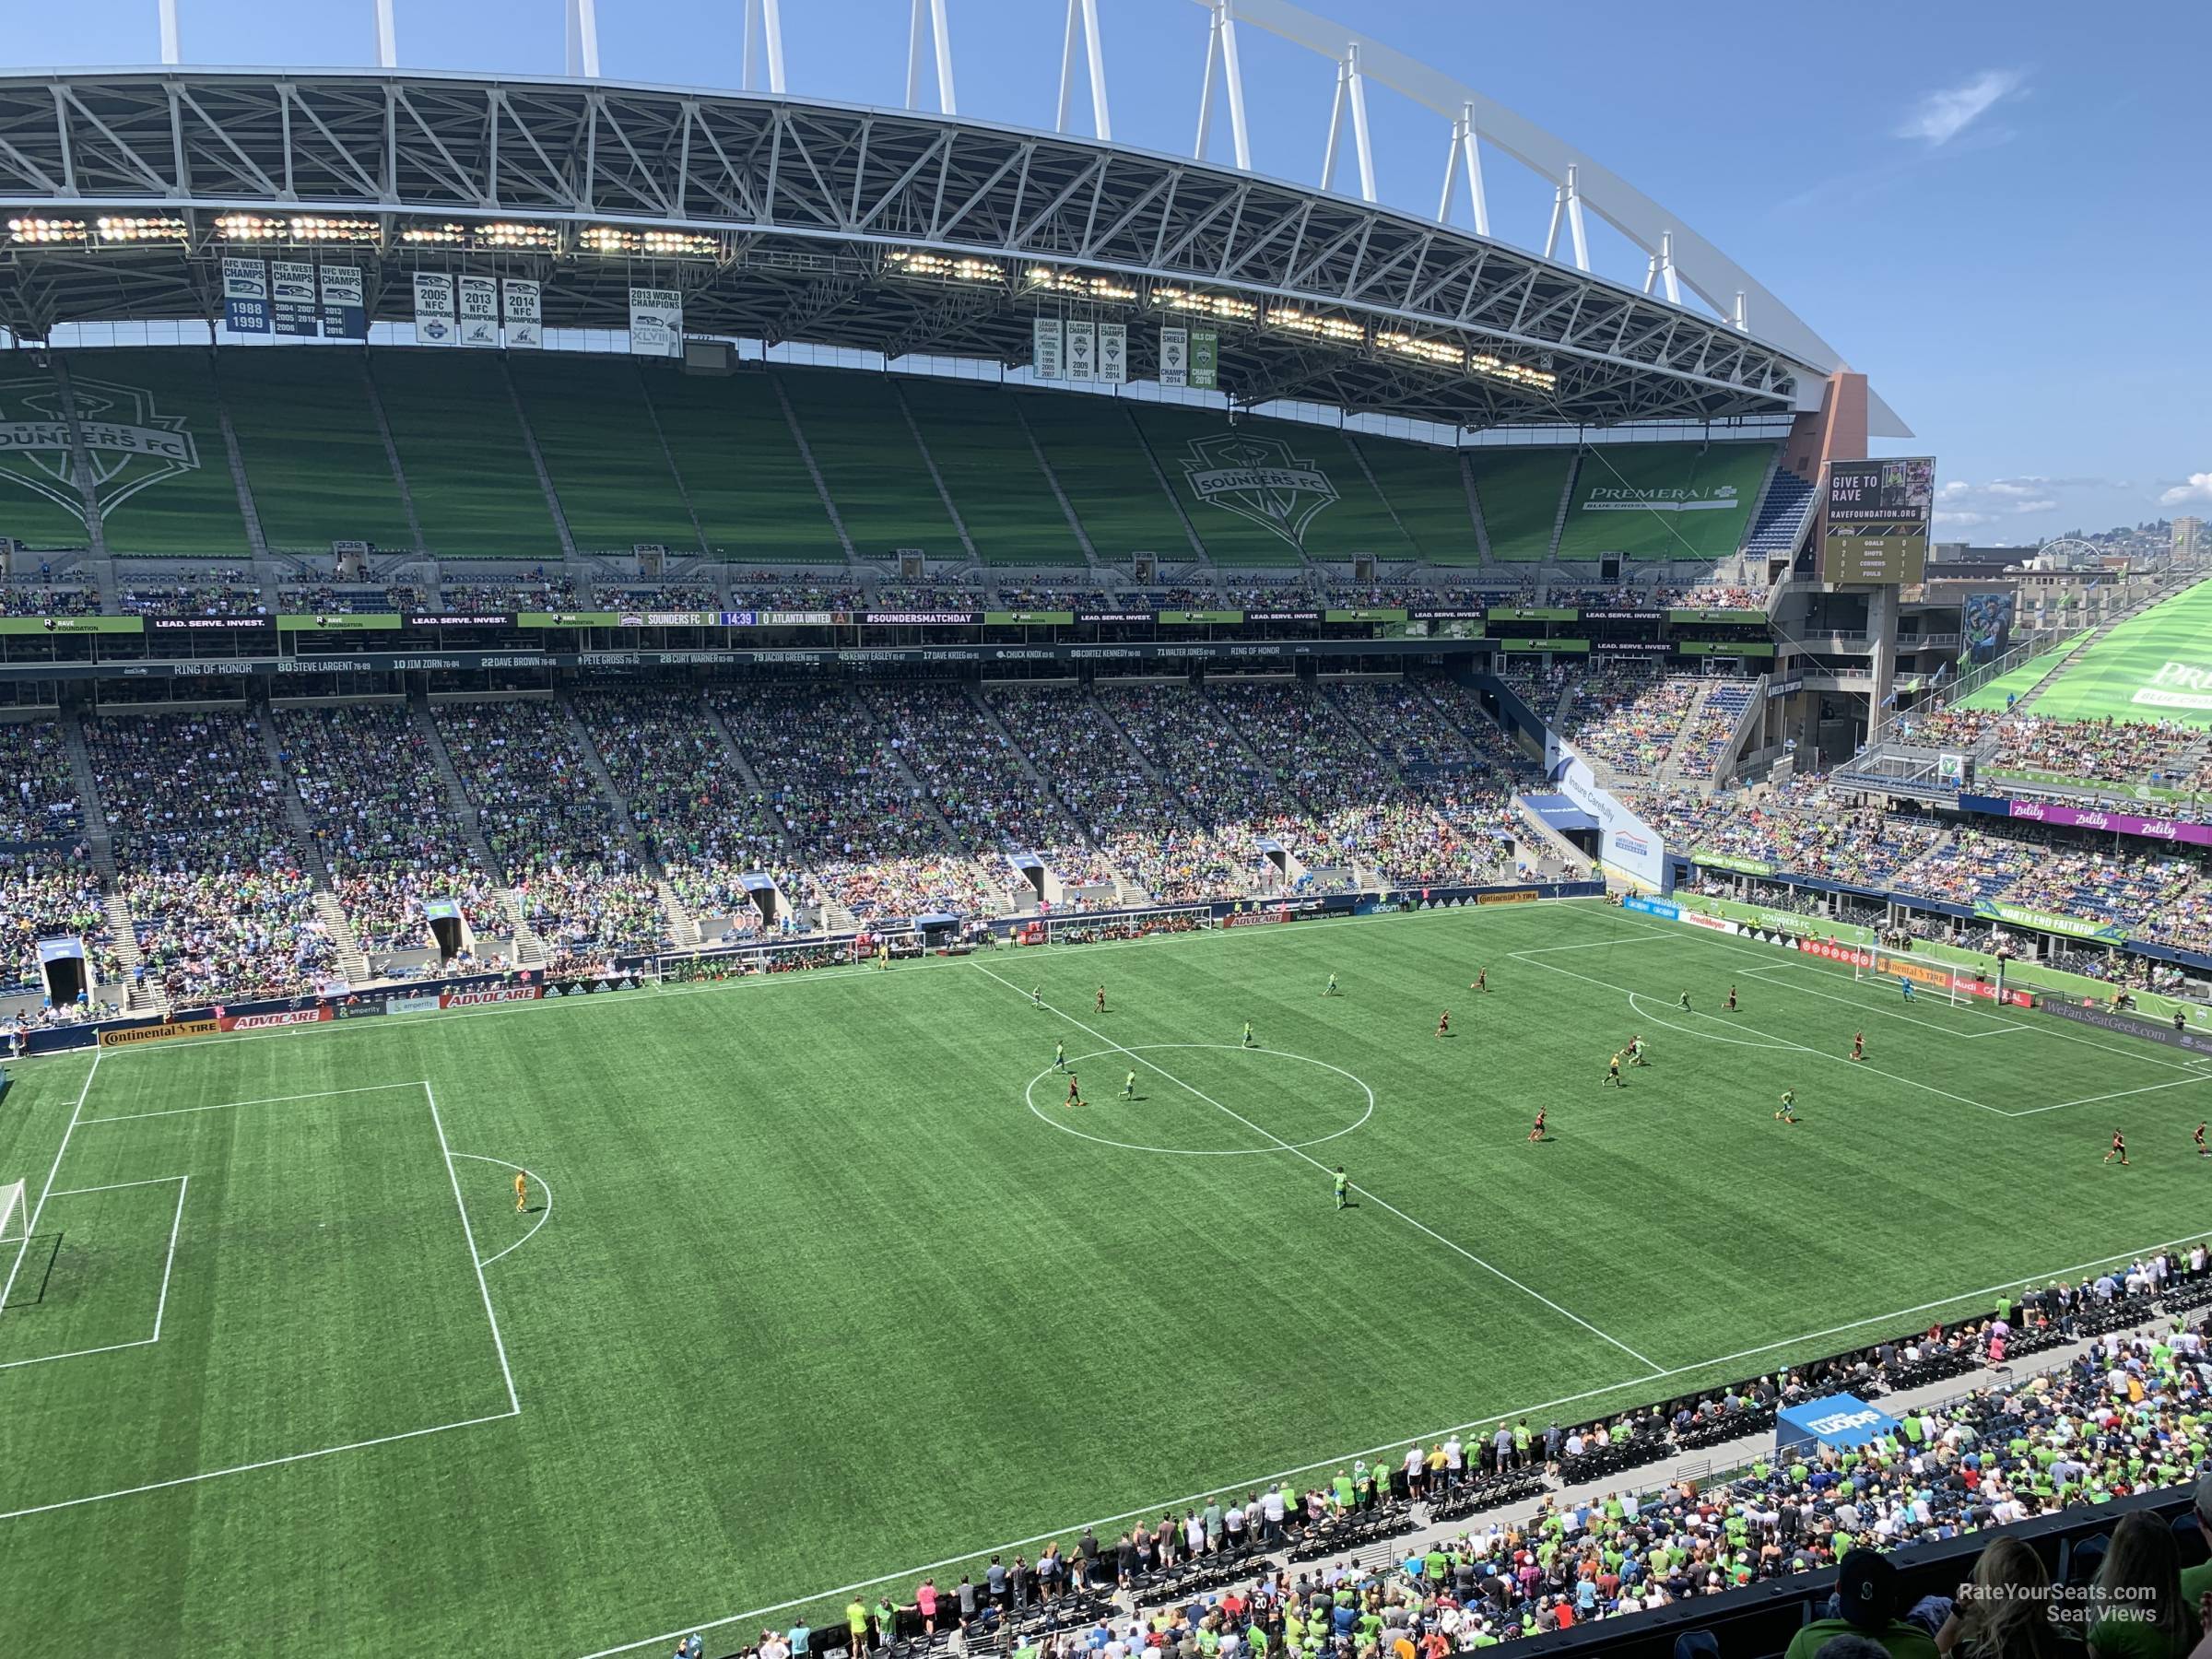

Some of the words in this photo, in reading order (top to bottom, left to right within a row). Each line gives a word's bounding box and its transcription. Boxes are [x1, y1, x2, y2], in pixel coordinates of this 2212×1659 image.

[241, 261, 263, 269] WEST
[290, 265, 312, 273] WEST
[224, 268, 265, 279] CHAMPS
[338, 268, 360, 276] WEST
[274, 272, 313, 283] CHAMPS
[323, 276, 360, 286] CHAMPS
[420, 289, 447, 300] 2005
[465, 293, 491, 304] 2013
[631, 290, 651, 300] 2013
[653, 291, 679, 300] WORLD
[425, 300, 443, 310] NFC
[509, 296, 535, 307] 2014
[631, 299, 679, 309] CHAMPIONS
[232, 302, 262, 314] 1988
[470, 305, 488, 313] NFC
[513, 308, 531, 316] NFC
[417, 310, 454, 318] CHAMPIONS
[461, 313, 498, 322] CHAMPIONS
[233, 317, 263, 328] 1999
[505, 316, 541, 324] CHAMPIONS
[632, 332, 668, 342] XLVIII
[1192, 369, 1216, 377] CHAMPS
[145, 438, 182, 456] FC
[1299, 477, 1325, 489] FC
[1833, 477, 1859, 488] GIVE
[1864, 476, 1877, 488] TO
[1590, 488, 1699, 500] PREMERA
[1831, 489, 1862, 501] RAVE
[1831, 510, 1916, 518] RAVEFOUNDATION.ORG
[336, 540, 362, 548] 332
[156, 619, 186, 628] LEAD.
[648, 615, 689, 624] SOUNDERS
[691, 615, 700, 624] FC
[708, 614, 714, 624] 0
[726, 614, 751, 624] 14:39
[763, 614, 769, 624] 0
[772, 614, 804, 624] ATLANTA
[805, 614, 830, 623] UNITED
[866, 614, 971, 623] #SOUNDERSMATCHDAY
[1026, 650, 1042, 658] KNOX
[1102, 649, 1127, 657] KENNEDY
[1158, 648, 1166, 656] 71
[1166, 648, 1185, 656] WALTER
[1187, 648, 1204, 656] JONES
[1230, 647, 1247, 655] RING
[1248, 647, 1257, 655] OF
[1258, 646, 1280, 654] HONOR
[583, 656, 600, 665] PETE
[602, 655, 624, 664] GROSS
[672, 654, 689, 664] CURT
[690, 654, 718, 663] WARNER
[764, 653, 783, 662] JACOB
[785, 653, 806, 662] GREEN
[849, 653, 870, 661] KENNY
[932, 652, 947, 660] DAVE
[947, 652, 966, 660] KRIEG
[277, 663, 292, 672] 80
[293, 663, 317, 672] STEVE
[318, 661, 353, 672] LARGENT
[394, 660, 406, 669] 10
[406, 660, 421, 668] JIM
[422, 659, 442, 668] ZORN
[481, 658, 494, 667] 22
[494, 657, 512, 667] DAVE
[513, 657, 540, 666] BROWN
[174, 665, 201, 675] RING
[203, 665, 217, 675] OF
[218, 664, 253, 674] HONOR
[1569, 775, 1587, 798] Insure
[1588, 792, 1614, 822] Carefully
[1695, 854, 1724, 864] WELCOME
[1479, 895, 1515, 903] Continental
[1371, 903, 1399, 914] slalom
[1230, 912, 1283, 928] ADVOCARE
[1761, 913, 1799, 926] SOUNDERS
[2001, 908, 2031, 924] NORTH
[2033, 915, 2052, 928] END
[2053, 920, 2095, 935] FAITHFUL
[1955, 979, 1976, 992] Audi
[447, 987, 536, 1007] ADVOCARE
[404, 1000, 433, 1010] amperity
[349, 1005, 381, 1016] amperity
[233, 1009, 320, 1030] ADVOCARE
[2045, 1001, 2166, 1041] WeFan.SeatGeek.com
[104, 1026, 176, 1046] Continental
[189, 1023, 217, 1033] TIRE
[1812, 1410, 1880, 1434] slalom
[2097, 1441, 2106, 1450] 10
[1255, 1597, 1266, 1609] 20
